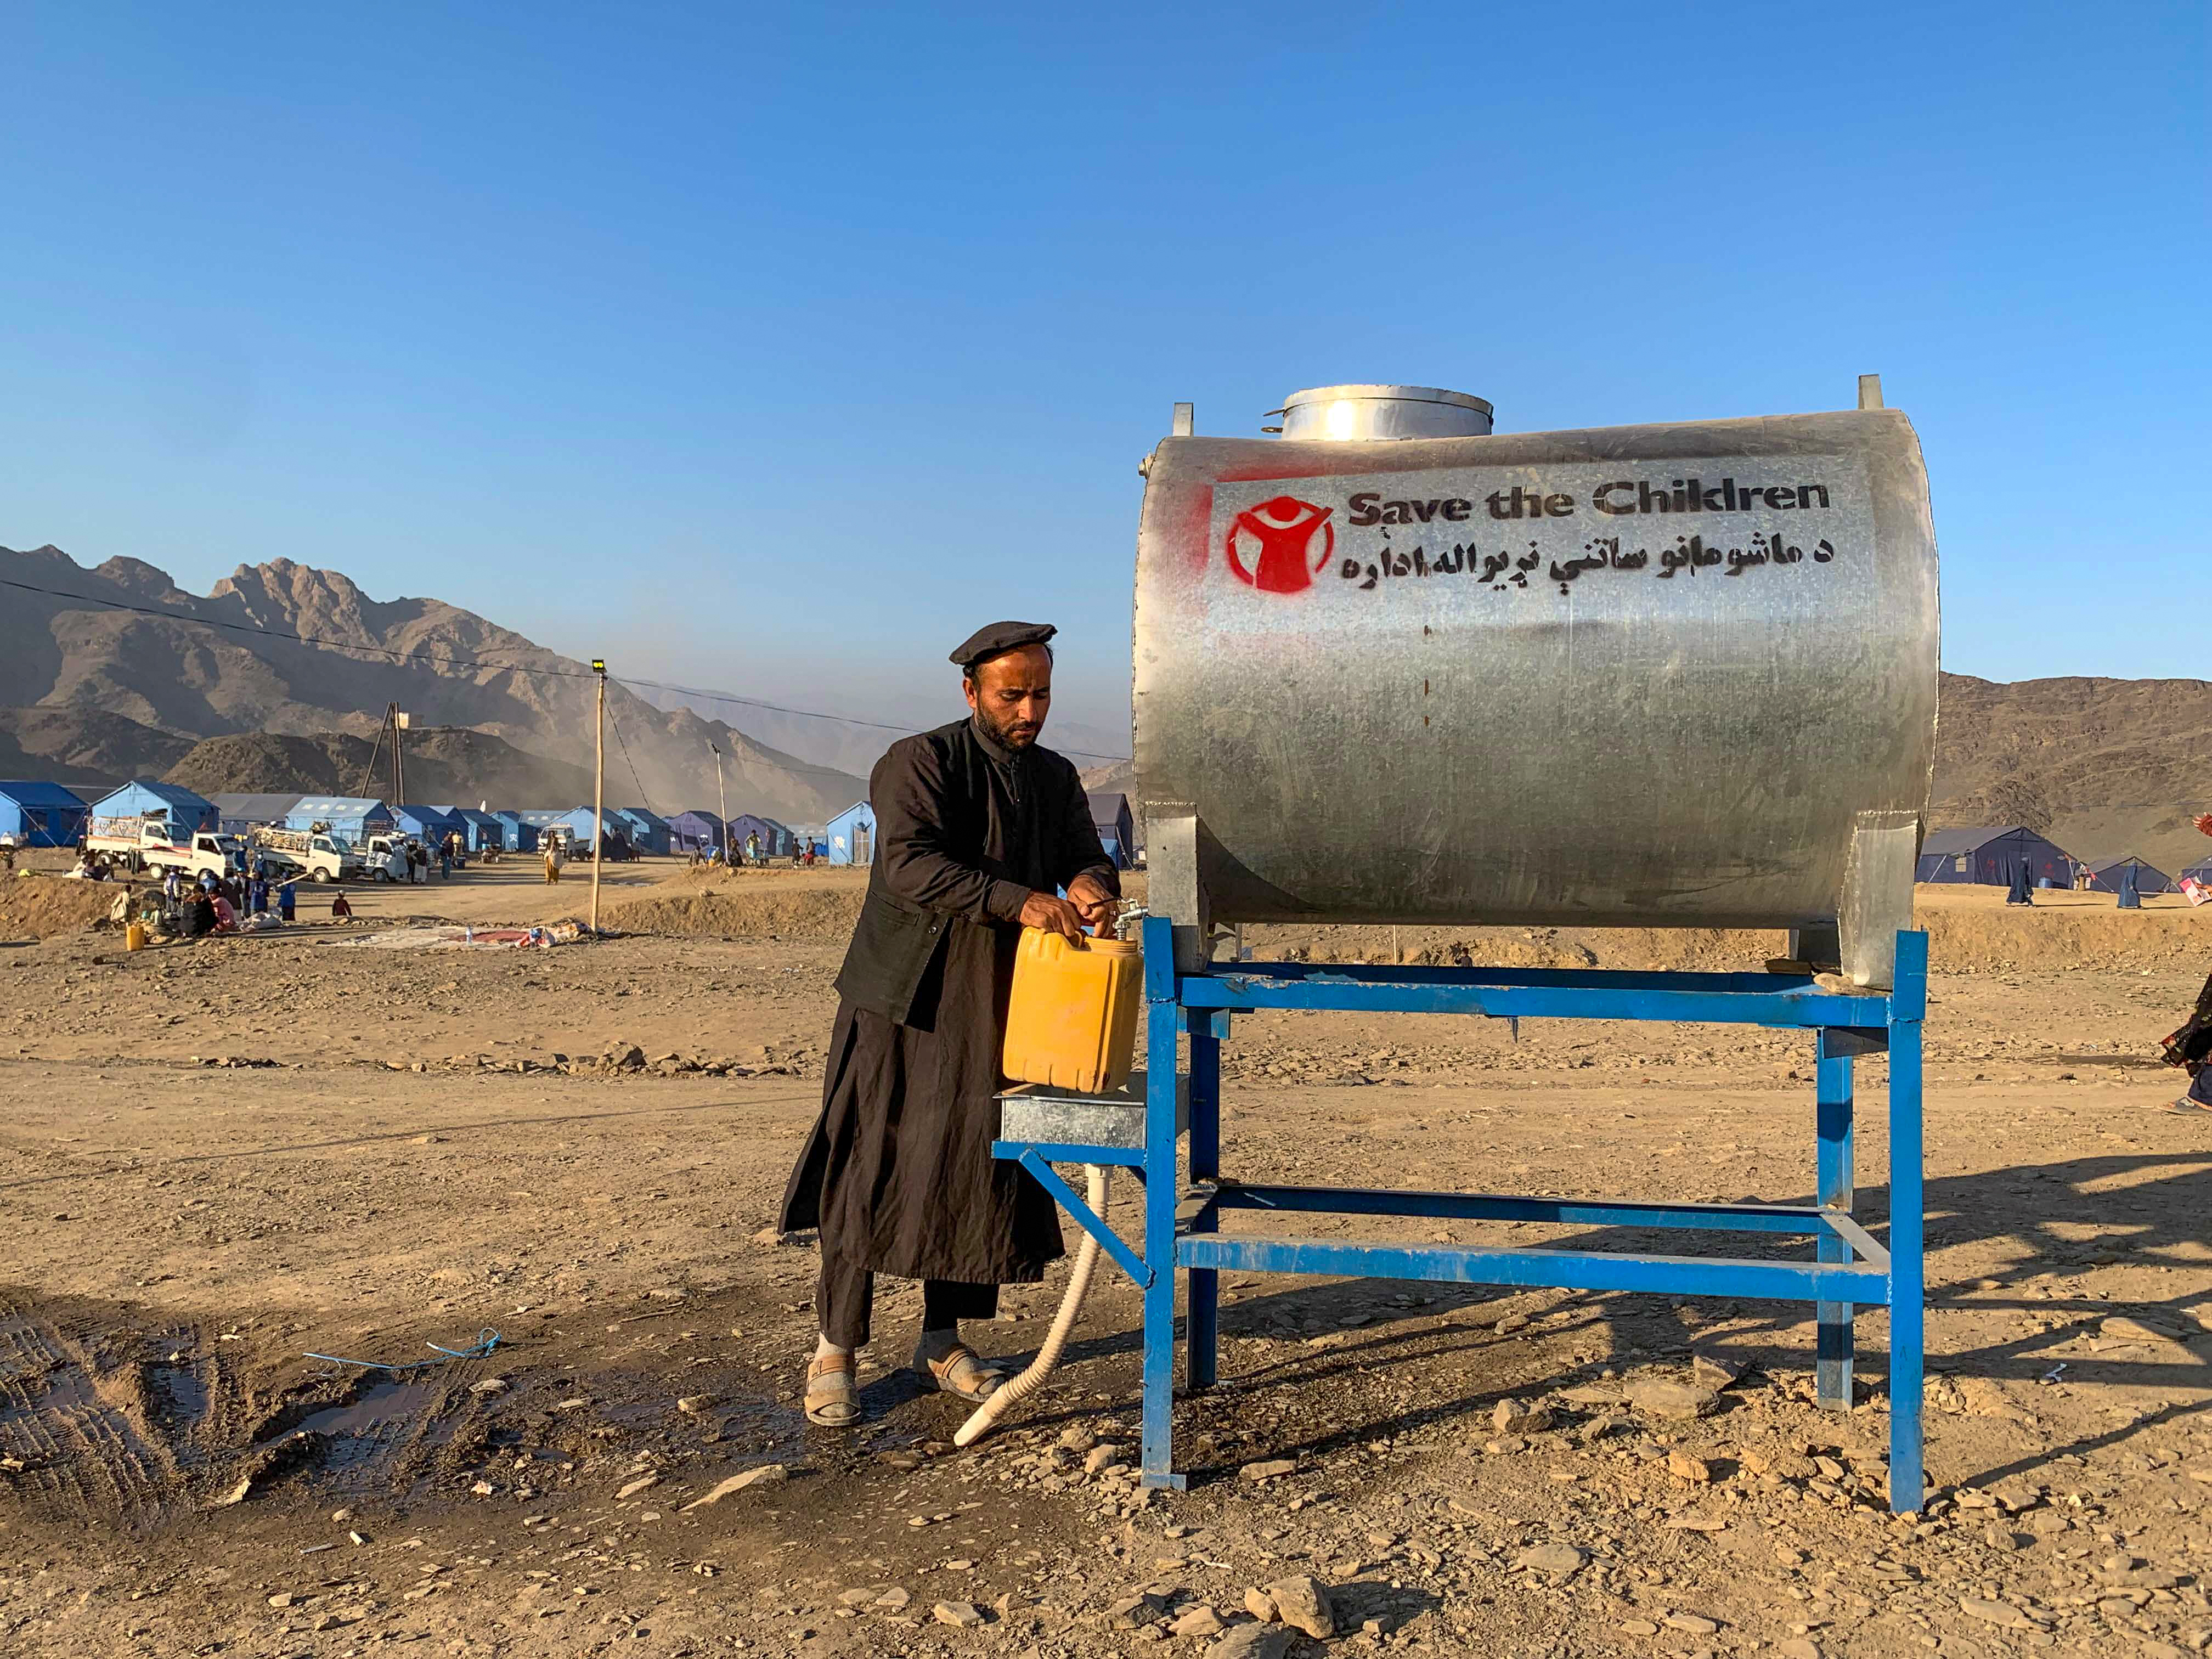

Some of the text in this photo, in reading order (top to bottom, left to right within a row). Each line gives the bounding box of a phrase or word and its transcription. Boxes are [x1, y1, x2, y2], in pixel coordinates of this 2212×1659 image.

[1348, 478, 1831, 526] Save the Children
[1813, 538, 1834, 563] د
